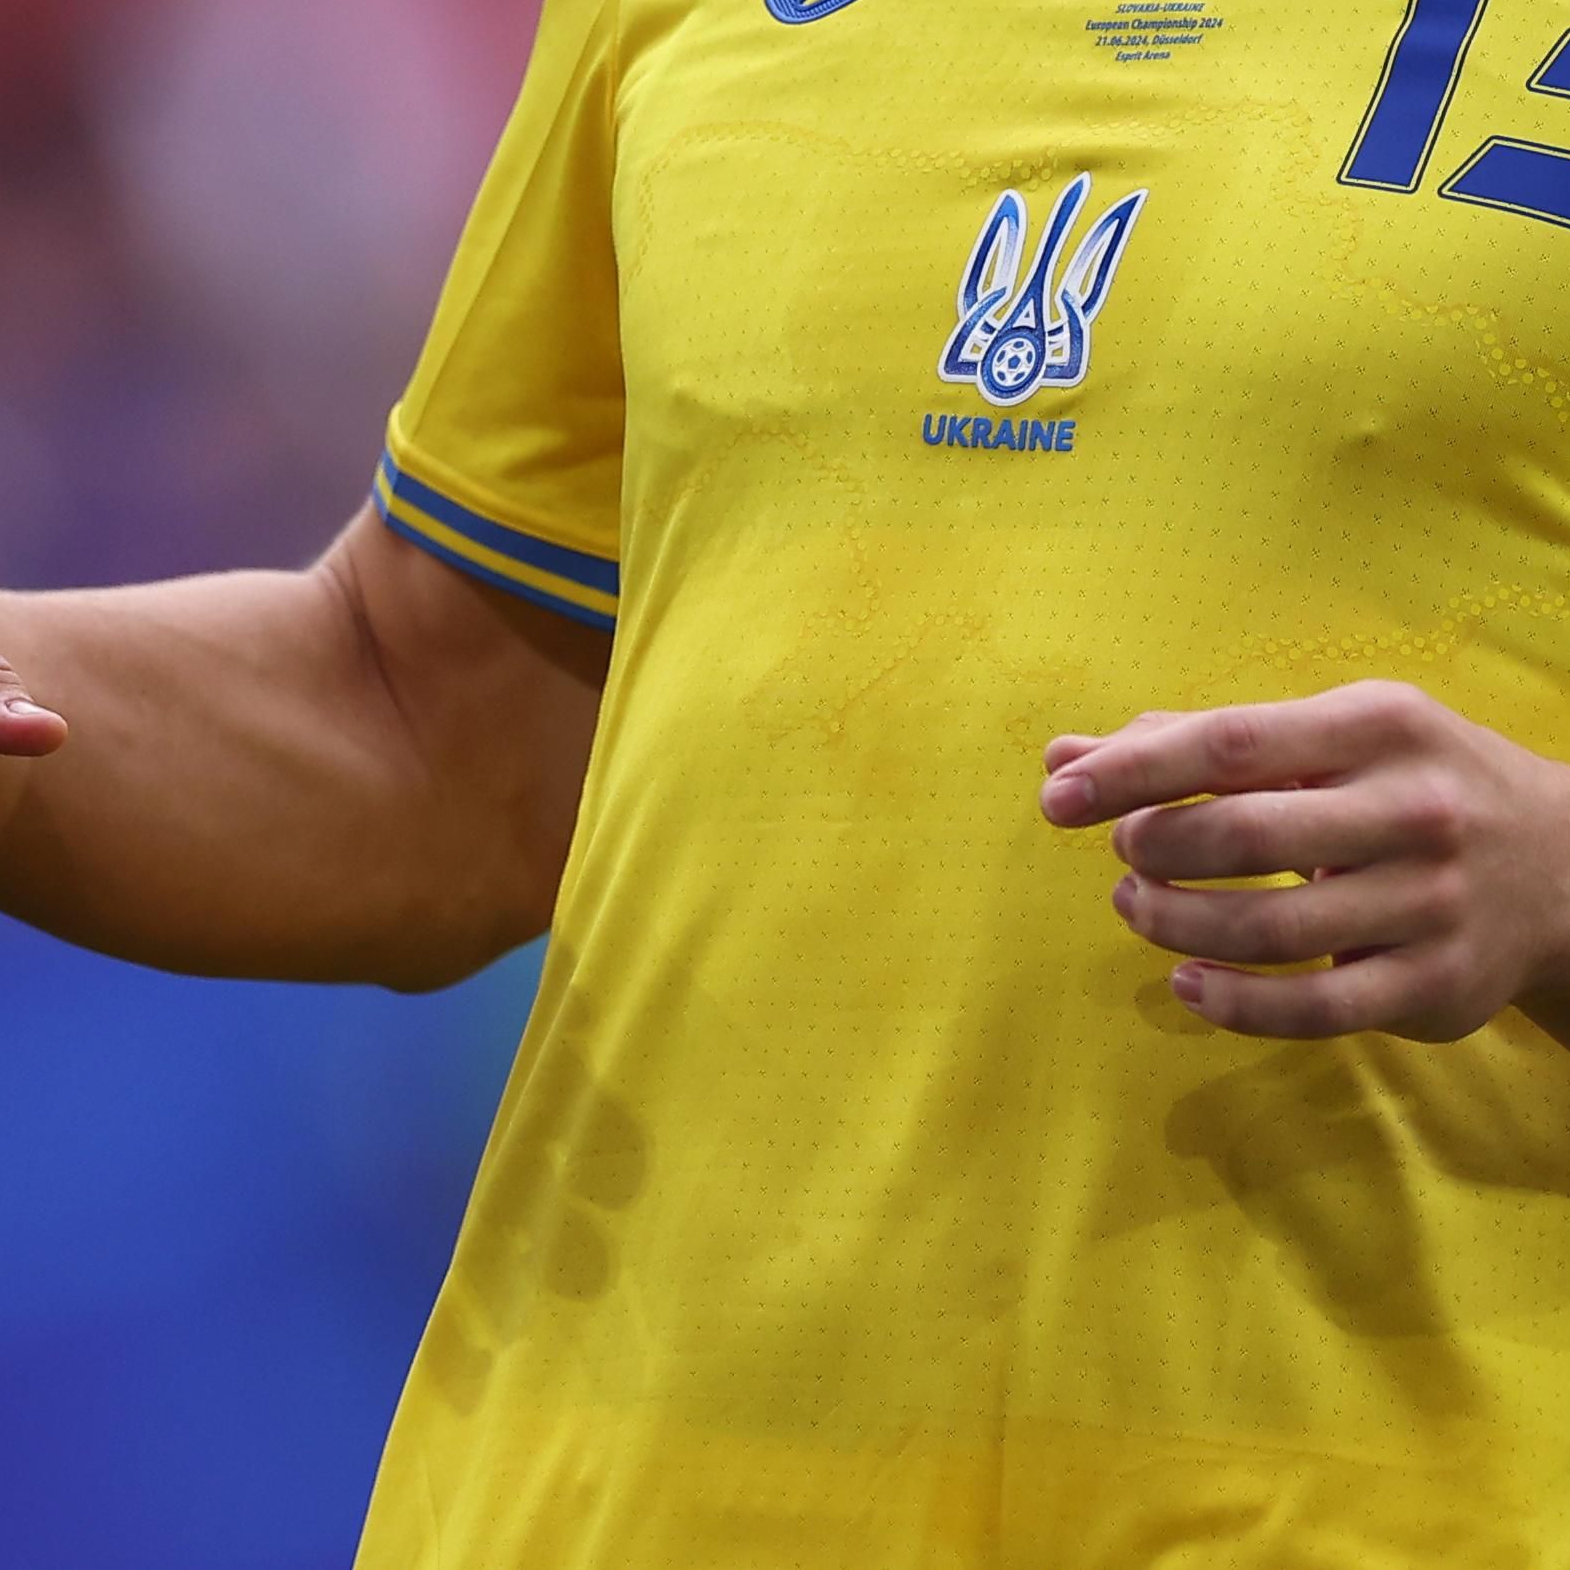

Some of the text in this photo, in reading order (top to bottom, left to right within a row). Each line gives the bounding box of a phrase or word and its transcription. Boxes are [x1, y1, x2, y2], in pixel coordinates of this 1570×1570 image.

[1086, 17, 1223, 32] European Championship 2024
[1096, 33, 1204, 46] 21.06.2024, Düsseldorf
[1115, 51, 1171, 62] Esprit Arena
[922, 413, 1076, 451] UKRAINE
